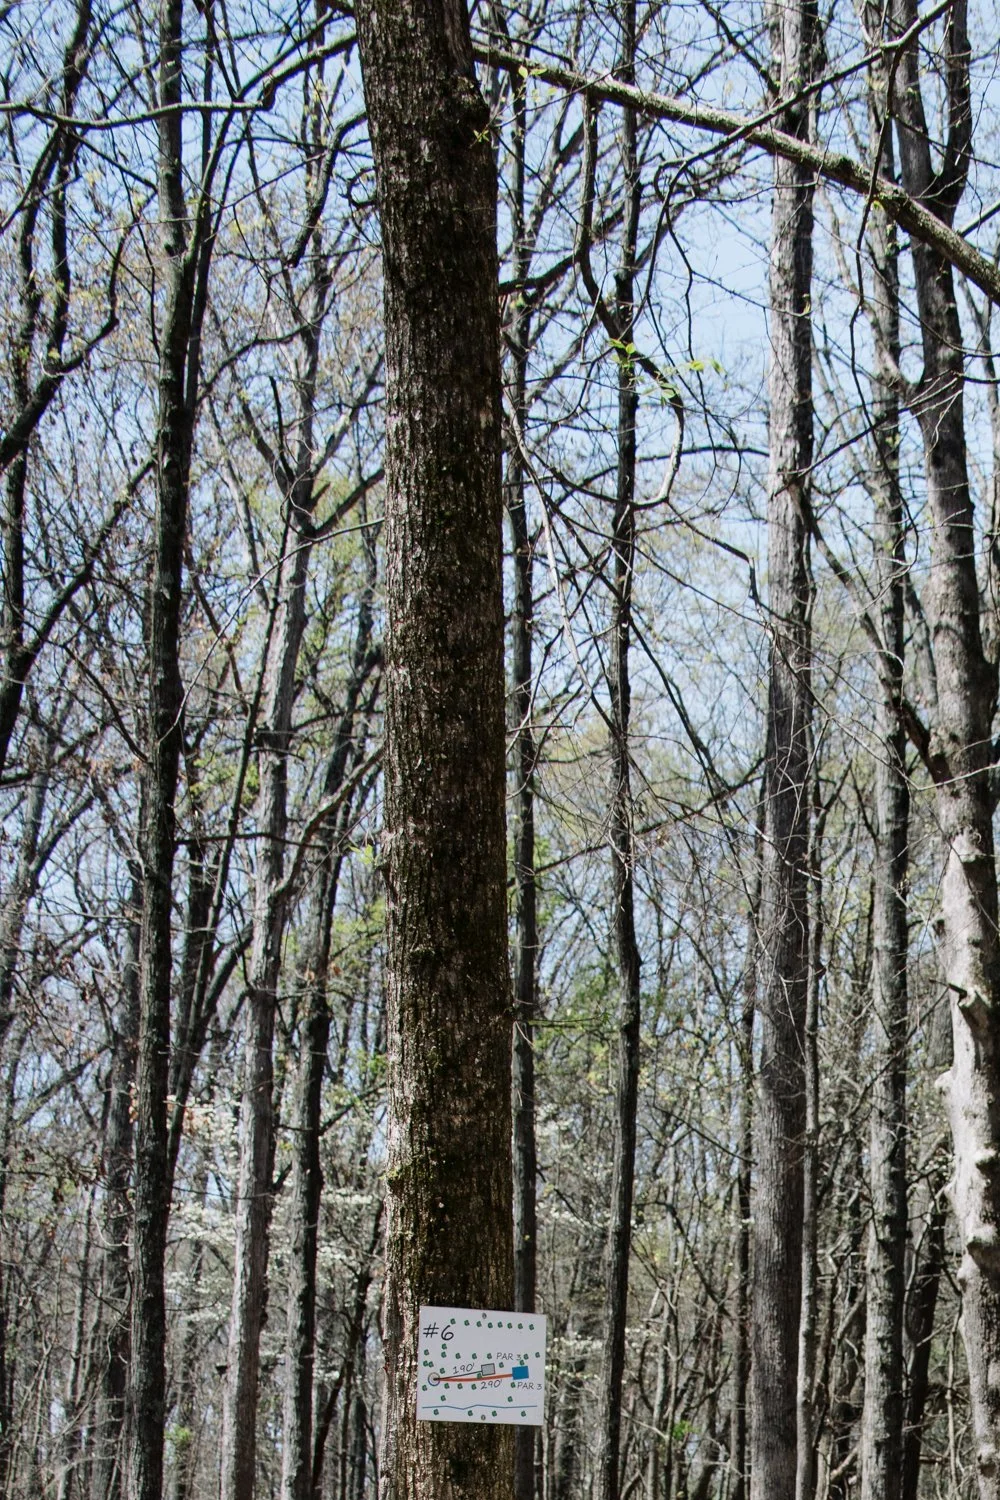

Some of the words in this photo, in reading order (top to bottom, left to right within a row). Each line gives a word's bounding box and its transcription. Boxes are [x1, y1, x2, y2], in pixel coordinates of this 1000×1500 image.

[423, 1322, 454, 1341] #6
[496, 1352, 513, 1360] PAR
[517, 1382, 534, 1390] PAR
